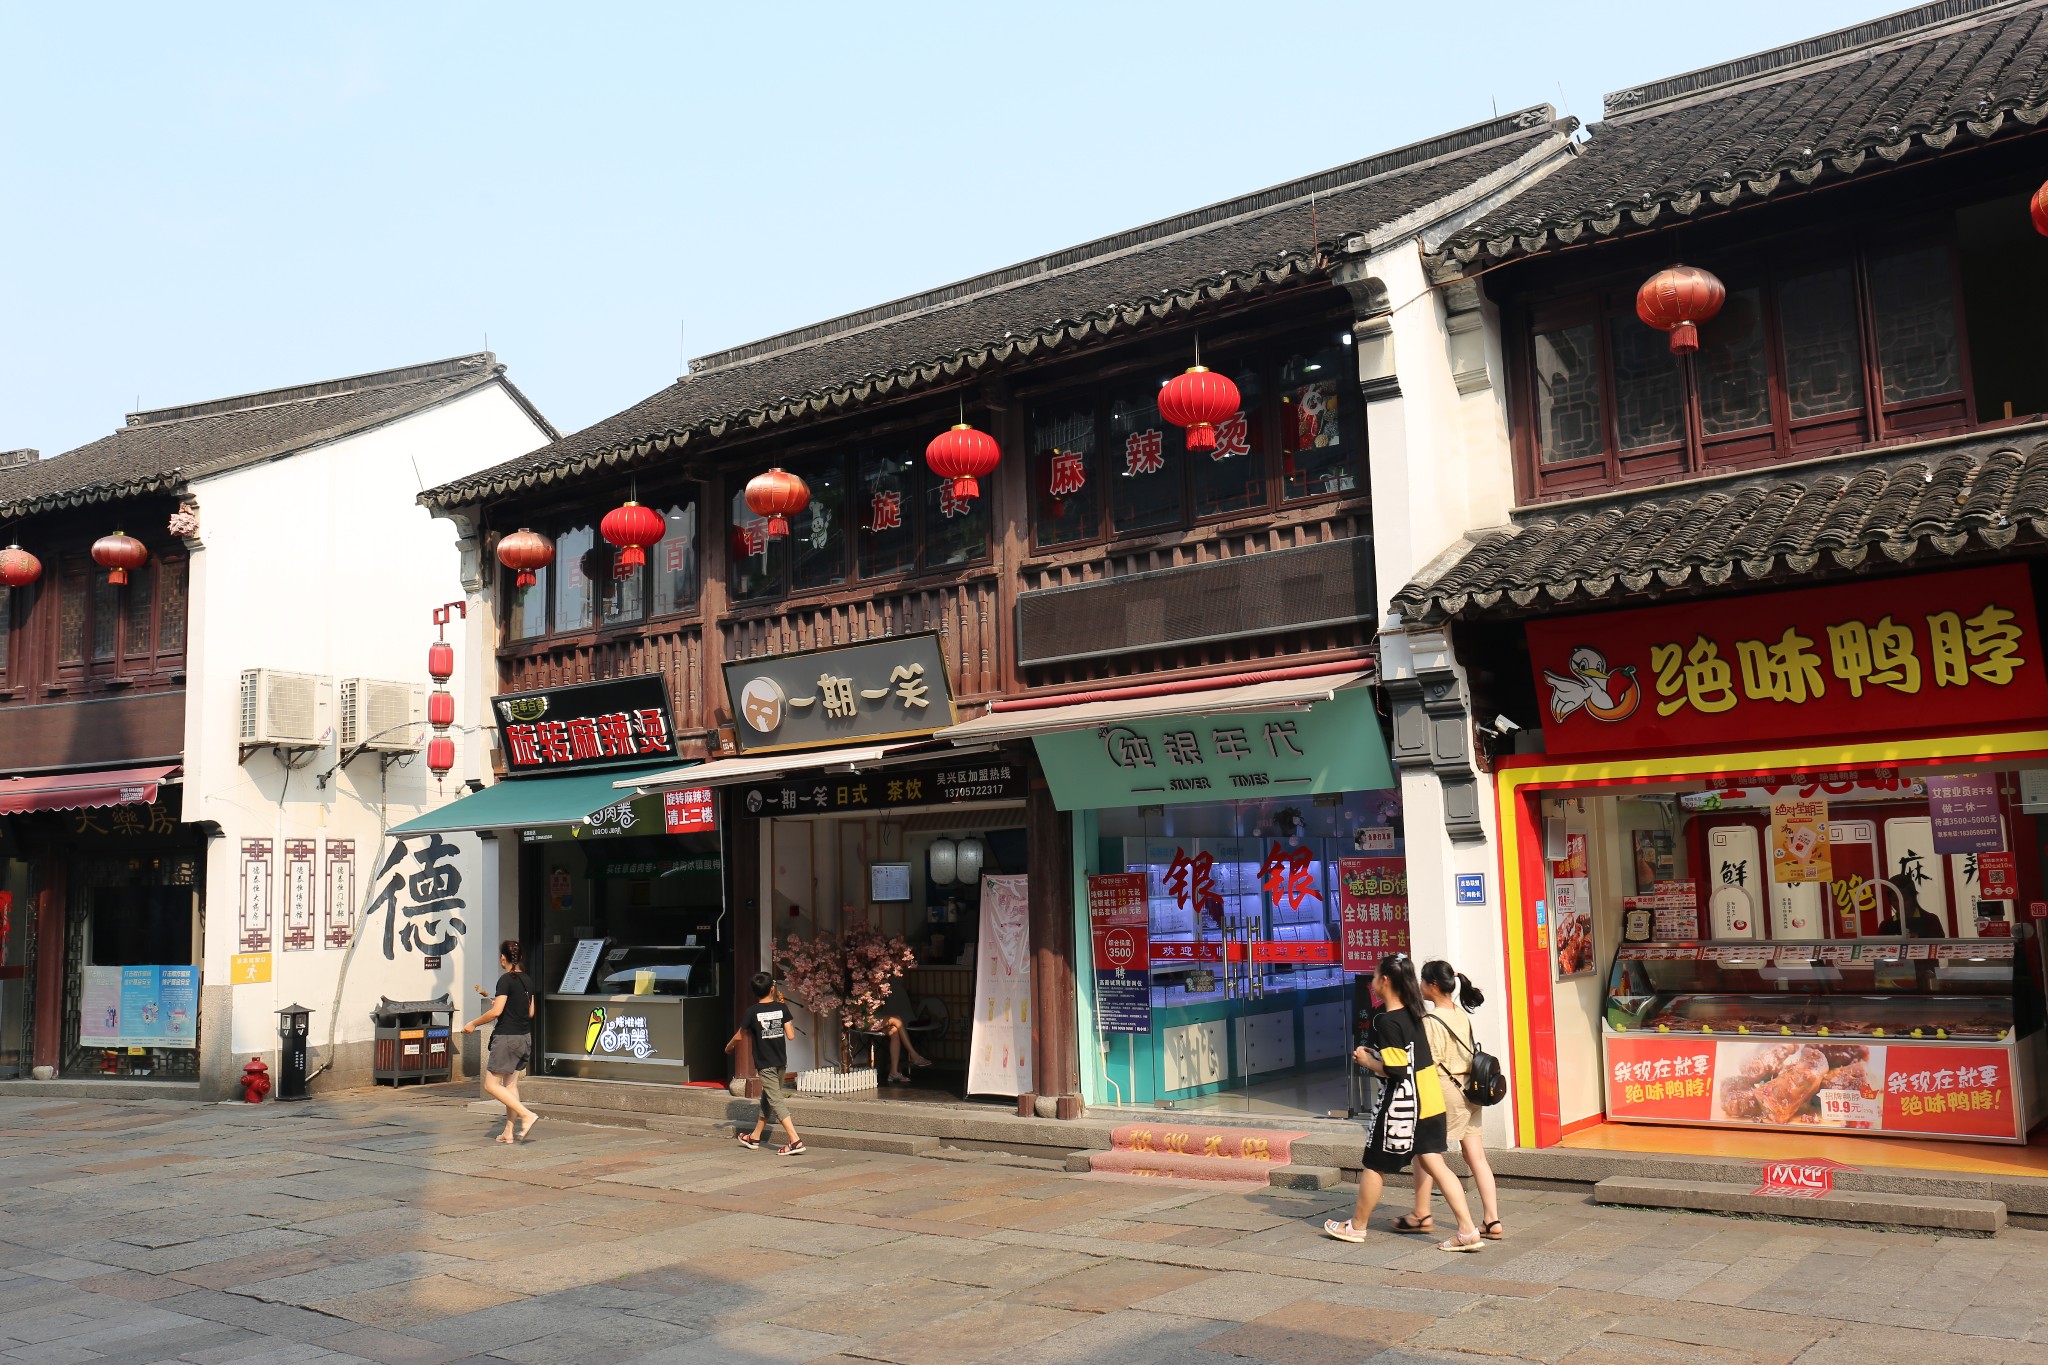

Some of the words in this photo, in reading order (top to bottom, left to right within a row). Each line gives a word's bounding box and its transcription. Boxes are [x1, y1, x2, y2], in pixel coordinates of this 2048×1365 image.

[1210, 411, 1251, 462] 烫
[1126, 429, 1165, 477] 辣
[1050, 451, 1086, 496] 麻
[872, 490, 901, 532] 旋
[745, 518, 769, 556] 香
[664, 536, 688, 574] 百
[565, 556, 587, 589] 百
[1650, 602, 2026, 718] 绝味鸭脖
[788, 662, 930, 719] 一期一笑
[510, 699, 547, 713] 百串百香
[505, 708, 671, 766] 旋转麻辣烫
[1117, 720, 1305, 770] 纯银年代
[937, 767, 1011, 785] 吴兴区加盟热线
[944, 783, 1003, 798] 13705722317
[1169, 776, 1212, 792] SILVER
[1228, 773, 1270, 788] TIMES
[1819, 771, 1859, 783] 绝味鸭脖
[666, 789, 712, 806] 旋转麻辣烫
[766, 786, 828, 810] 一期一笑
[836, 784, 868, 806] 日式
[887, 778, 923, 802] 茶饮
[1932, 786, 1994, 798] 女营业员若干名
[667, 807, 714, 827] 请上二楼
[1942, 802, 1988, 814] 做二休一
[1162, 846, 1224, 914] 银
[1256, 839, 1325, 911] 银
[1349, 879, 1409, 897] 感恩回馈
[1720, 860, 1748, 888] 鲜
[367, 833, 467, 960] 德
[1830, 873, 1877, 915] 绝
[1109, 948, 1131, 957] 3500
[1257, 946, 1329, 957] 欢迎光临
[1115, 965, 1126, 980] 聘
[1614, 1055, 1712, 1082] 我现在就要
[1887, 1064, 2000, 1094] 我现在就要
[1625, 1077, 1712, 1104] 绝味鸭脖!
[1900, 1088, 2001, 1117] 绝味鸭脖!
